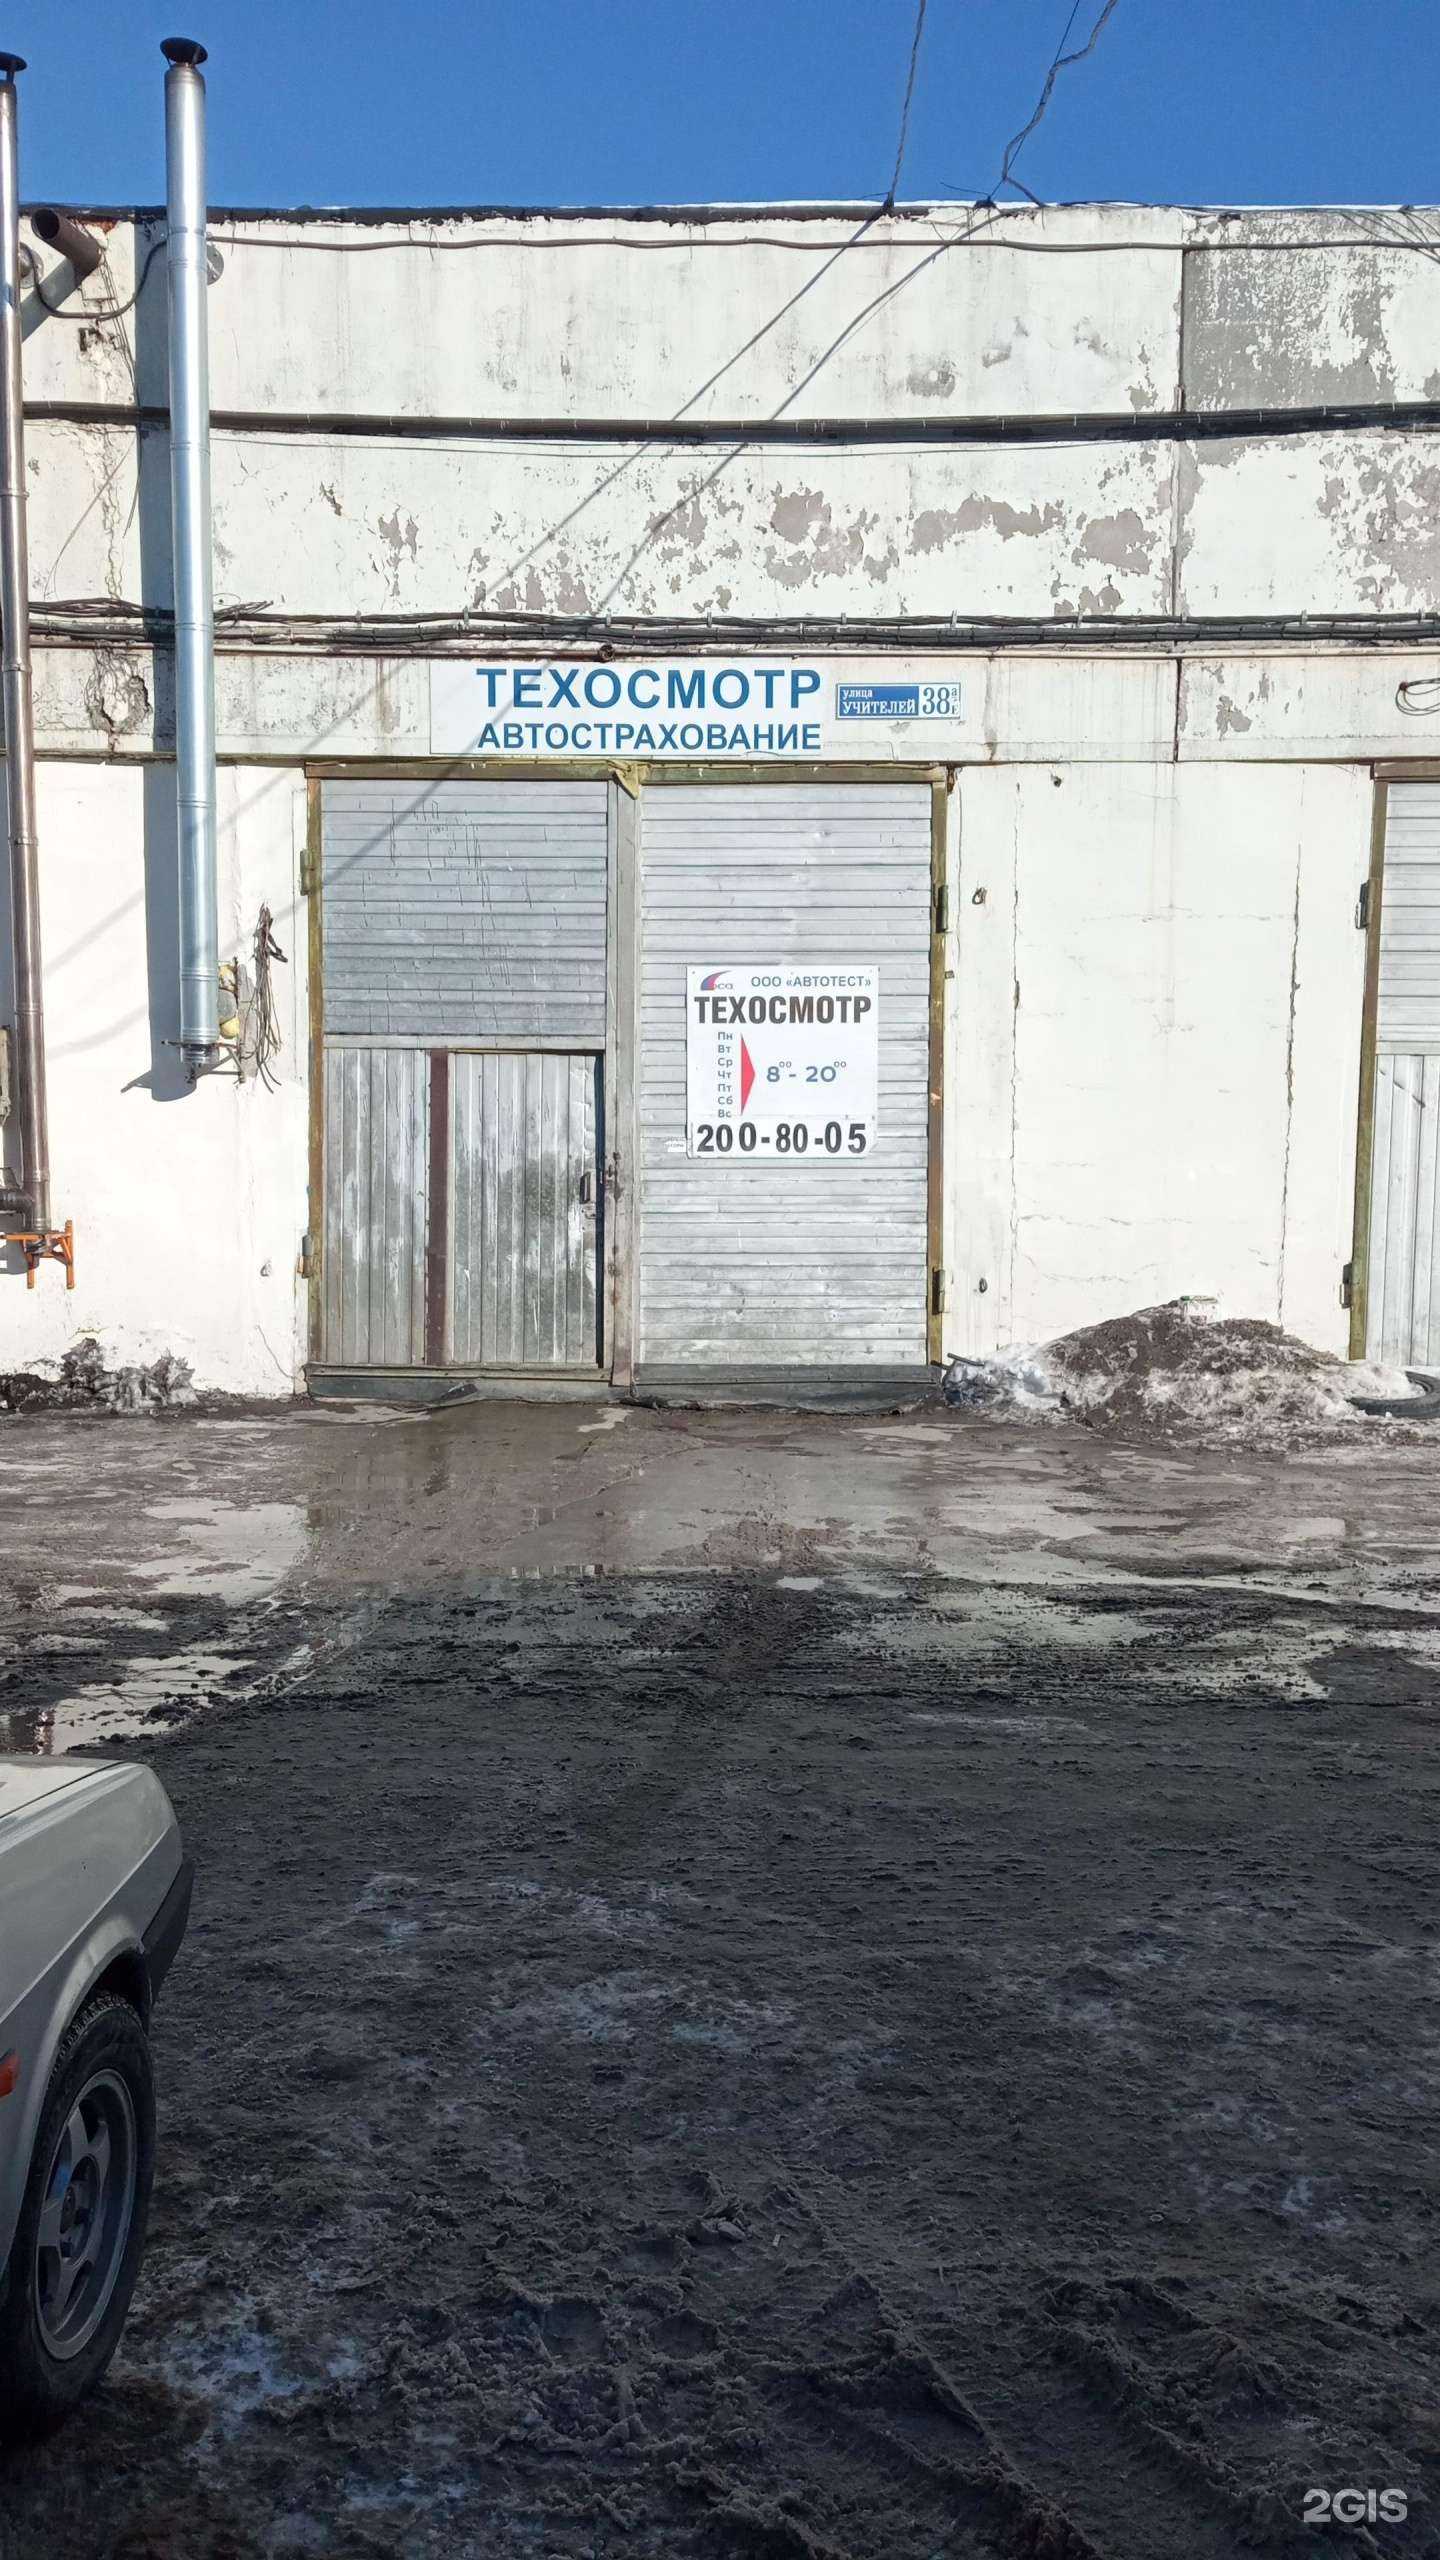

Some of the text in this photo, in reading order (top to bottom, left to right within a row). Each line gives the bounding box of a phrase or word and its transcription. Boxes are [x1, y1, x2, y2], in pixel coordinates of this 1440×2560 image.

[476, 668, 821, 709] ТЕХОСМОТР
[842, 689, 873, 700] улица
[842, 699, 917, 714] УЧИТЕЛЕЙ
[478, 723, 821, 750] АВТОСТРАХОВАНИЕ
[751, 976, 871, 987] ООО «АВТОТЕСТ»
[694, 996, 872, 1024] ТЕХОСМОТР
[718, 1032, 733, 1040] Пн
[718, 1044, 731, 1053] Вт
[718, 1058, 733, 1068] Ср
[718, 1071, 731, 1079] Чт
[718, 1084, 731, 1092] Пт
[718, 1096, 733, 1105] Сб
[718, 1109, 732, 1118] Вс
[697, 1121, 867, 1153] 200-80-05
